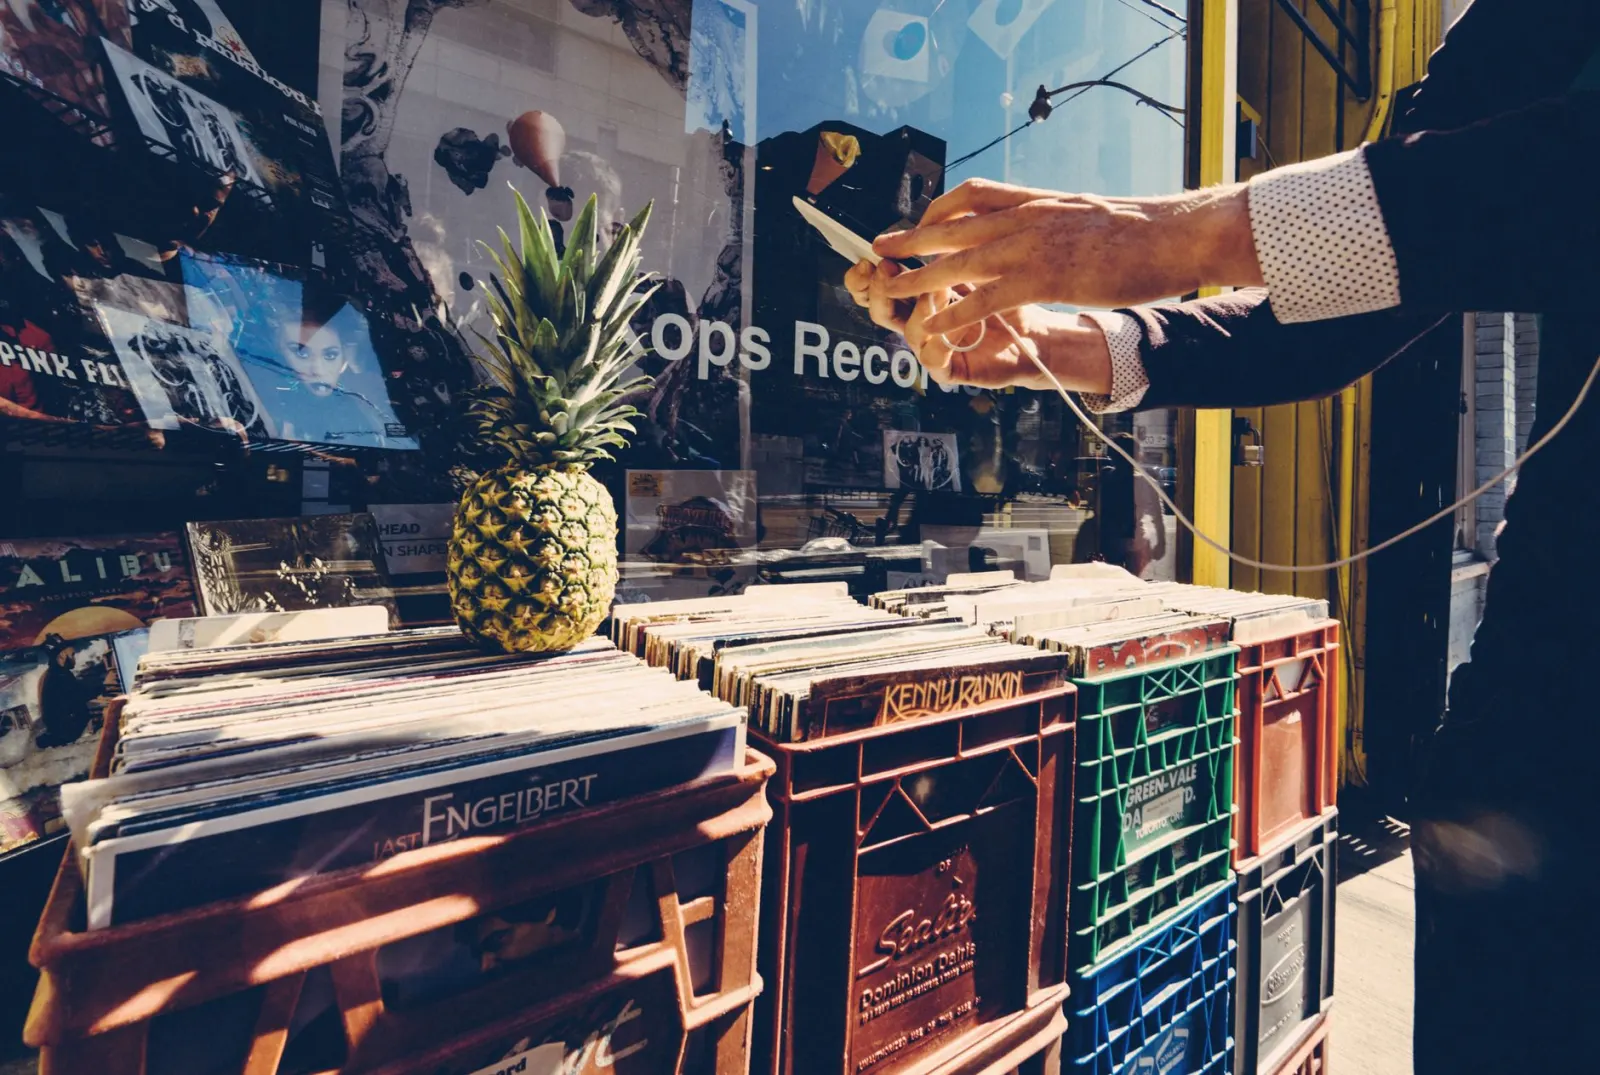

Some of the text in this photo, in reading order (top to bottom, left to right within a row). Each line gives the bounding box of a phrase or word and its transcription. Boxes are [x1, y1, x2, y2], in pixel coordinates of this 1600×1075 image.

[625, 313, 984, 395] ops Recor
[379, 523, 421, 535] HEAD
[397, 543, 447, 556] SHAPE
[881, 670, 1024, 725] KENNY RANKIN
[1125, 763, 1197, 808] GREEN-VALE
[422, 774, 598, 846] ENGELBERT
[861, 962, 933, 1008] Dominion
